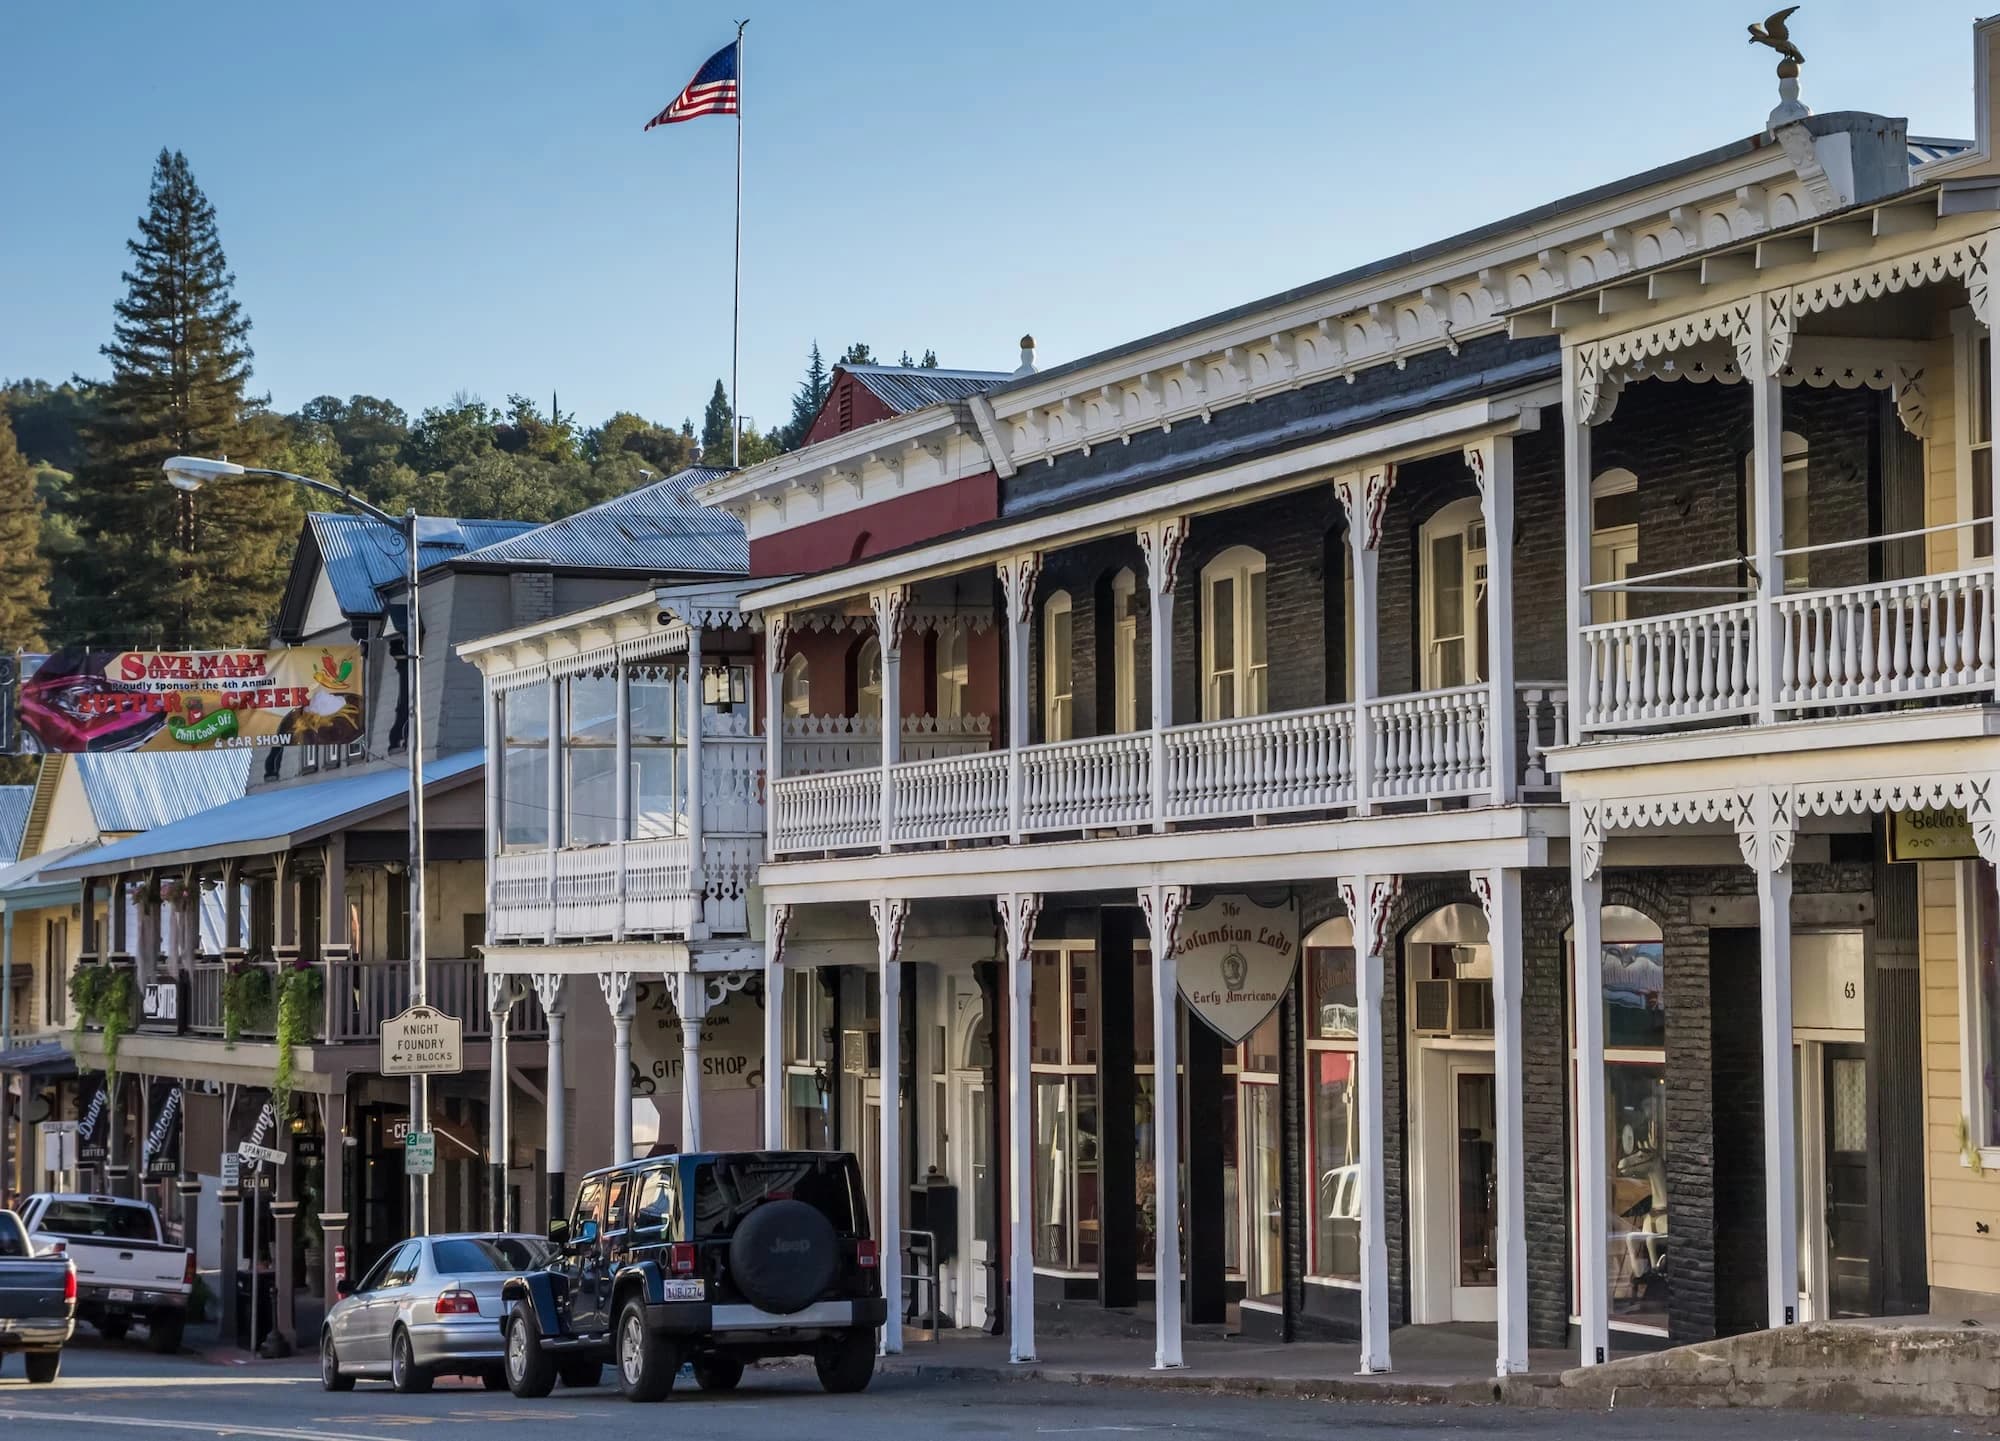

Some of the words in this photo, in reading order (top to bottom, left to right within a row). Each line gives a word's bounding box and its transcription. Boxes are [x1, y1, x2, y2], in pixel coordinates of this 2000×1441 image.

[121, 653, 193, 680] SAVE
[199, 653, 267, 670] MART
[112, 681, 152, 692] Proudly
[155, 681, 199, 691] Sponsors
[202, 681, 219, 690] the
[221, 680, 238, 690] 4th
[242, 678, 276, 689] Annual
[79, 692, 183, 714] SUTTER
[220, 687, 310, 710] CREEK
[175, 726, 195, 741] Chili
[214, 737, 223, 749] &
[227, 736, 252, 748] CAR
[256, 733, 292, 746] SHOW
[1904, 809, 1966, 830] Bella's
[1222, 901, 1241, 917] The
[1175, 925, 1252, 955] Columbian
[1256, 926, 1293, 957] Lady
[1193, 991, 1222, 1006] Early
[1225, 990, 1278, 1004] Americana
[1844, 981, 1856, 999] 63
[706, 1016, 730, 1026] GUM
[403, 1024, 439, 1036] KNIGHT
[397, 1038, 445, 1051] FOUNDRY
[407, 1053, 413, 1062] 2
[416, 1052, 453, 1062] BLOCKS
[652, 1059, 683, 1079] GIF
[703, 1056, 748, 1075] SHOP
[79, 1088, 107, 1141] Dining
[146, 1087, 181, 1154] Welcome
[408, 1134, 416, 1145] 2
[243, 1144, 273, 1161] SPANISH
[768, 1236, 811, 1254] Jeep
